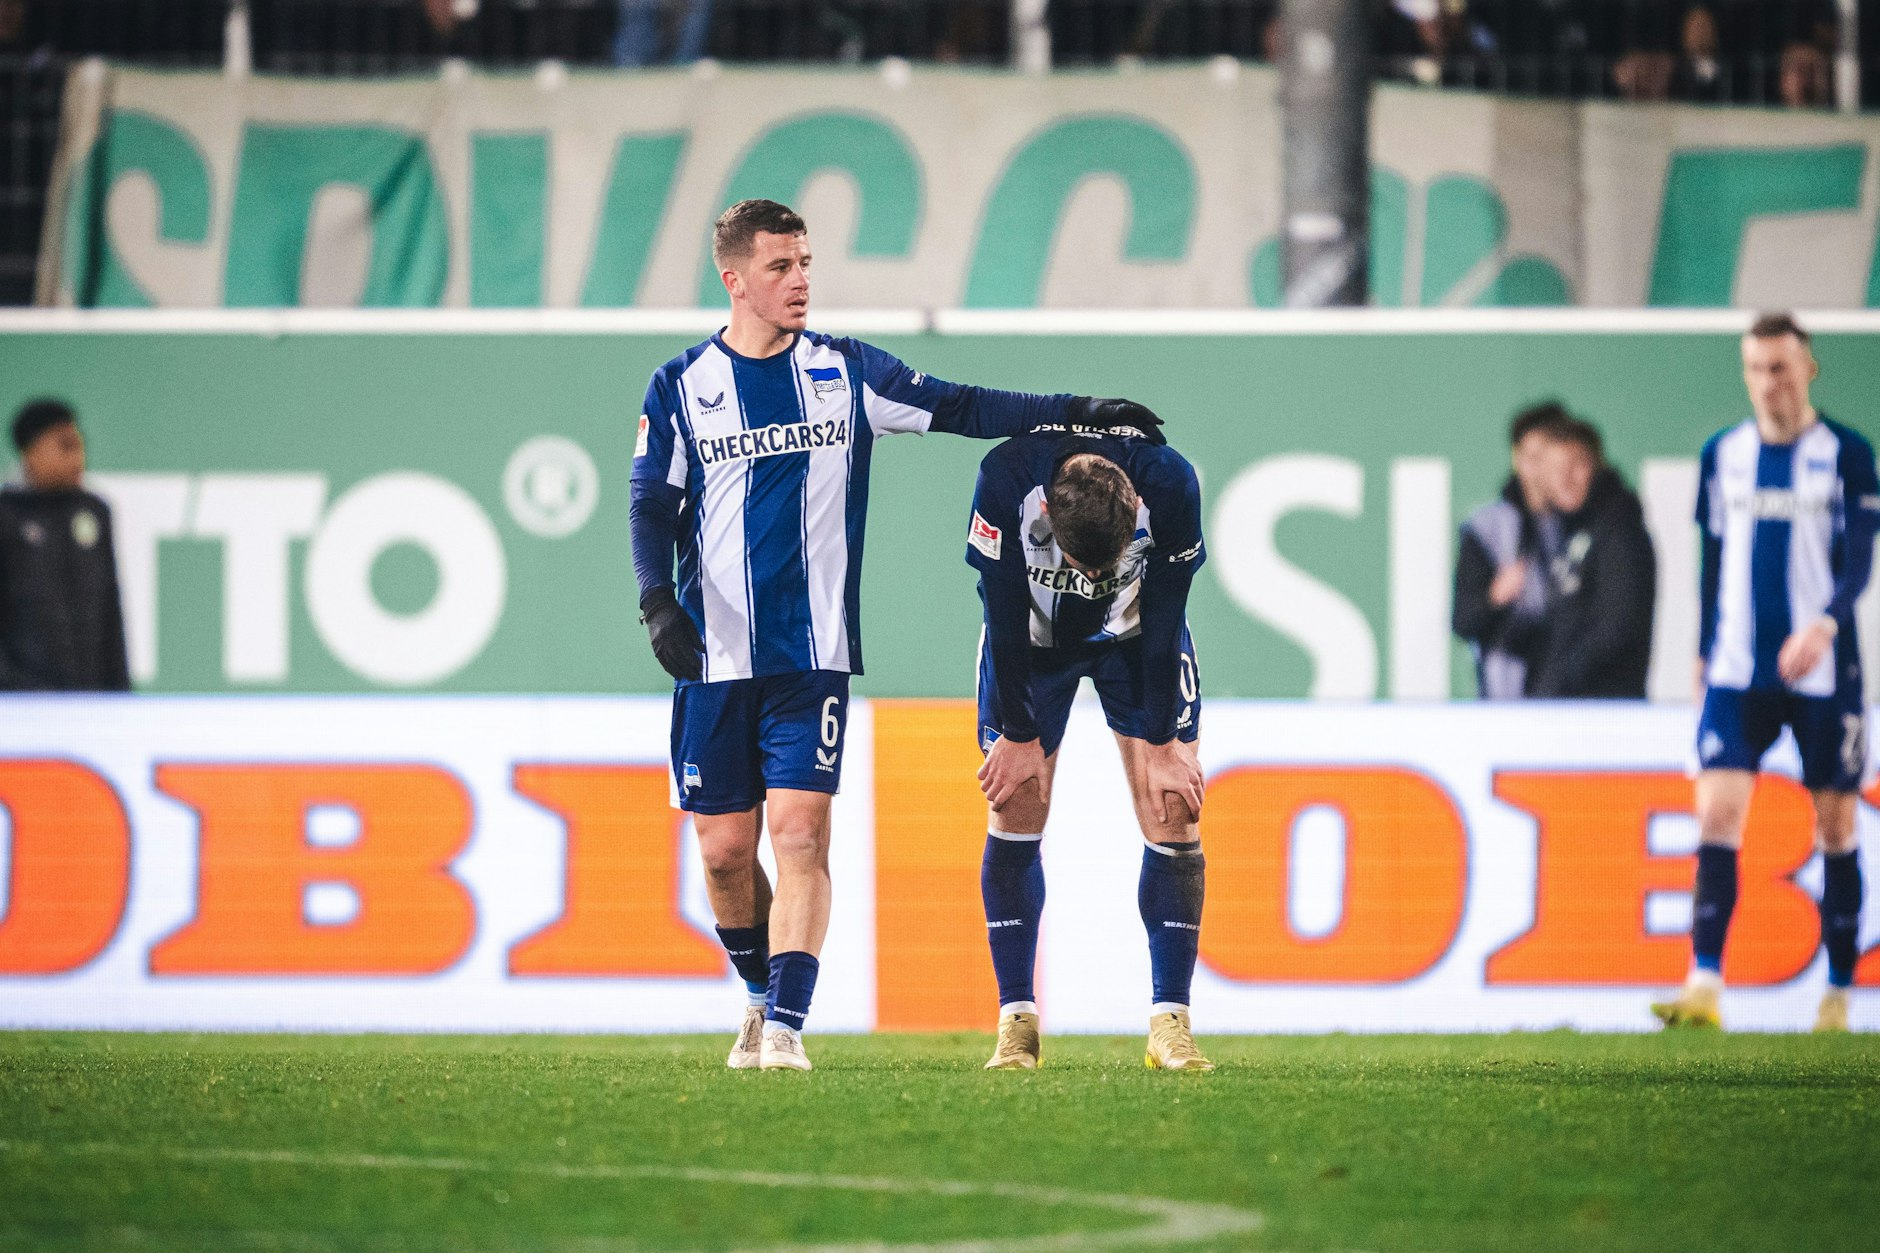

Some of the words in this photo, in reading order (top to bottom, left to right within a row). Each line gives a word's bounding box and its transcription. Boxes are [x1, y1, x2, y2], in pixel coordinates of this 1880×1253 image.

[84, 468, 508, 688] TTO
[821, 696, 839, 748] 6
[1194, 765, 1880, 985] OB
